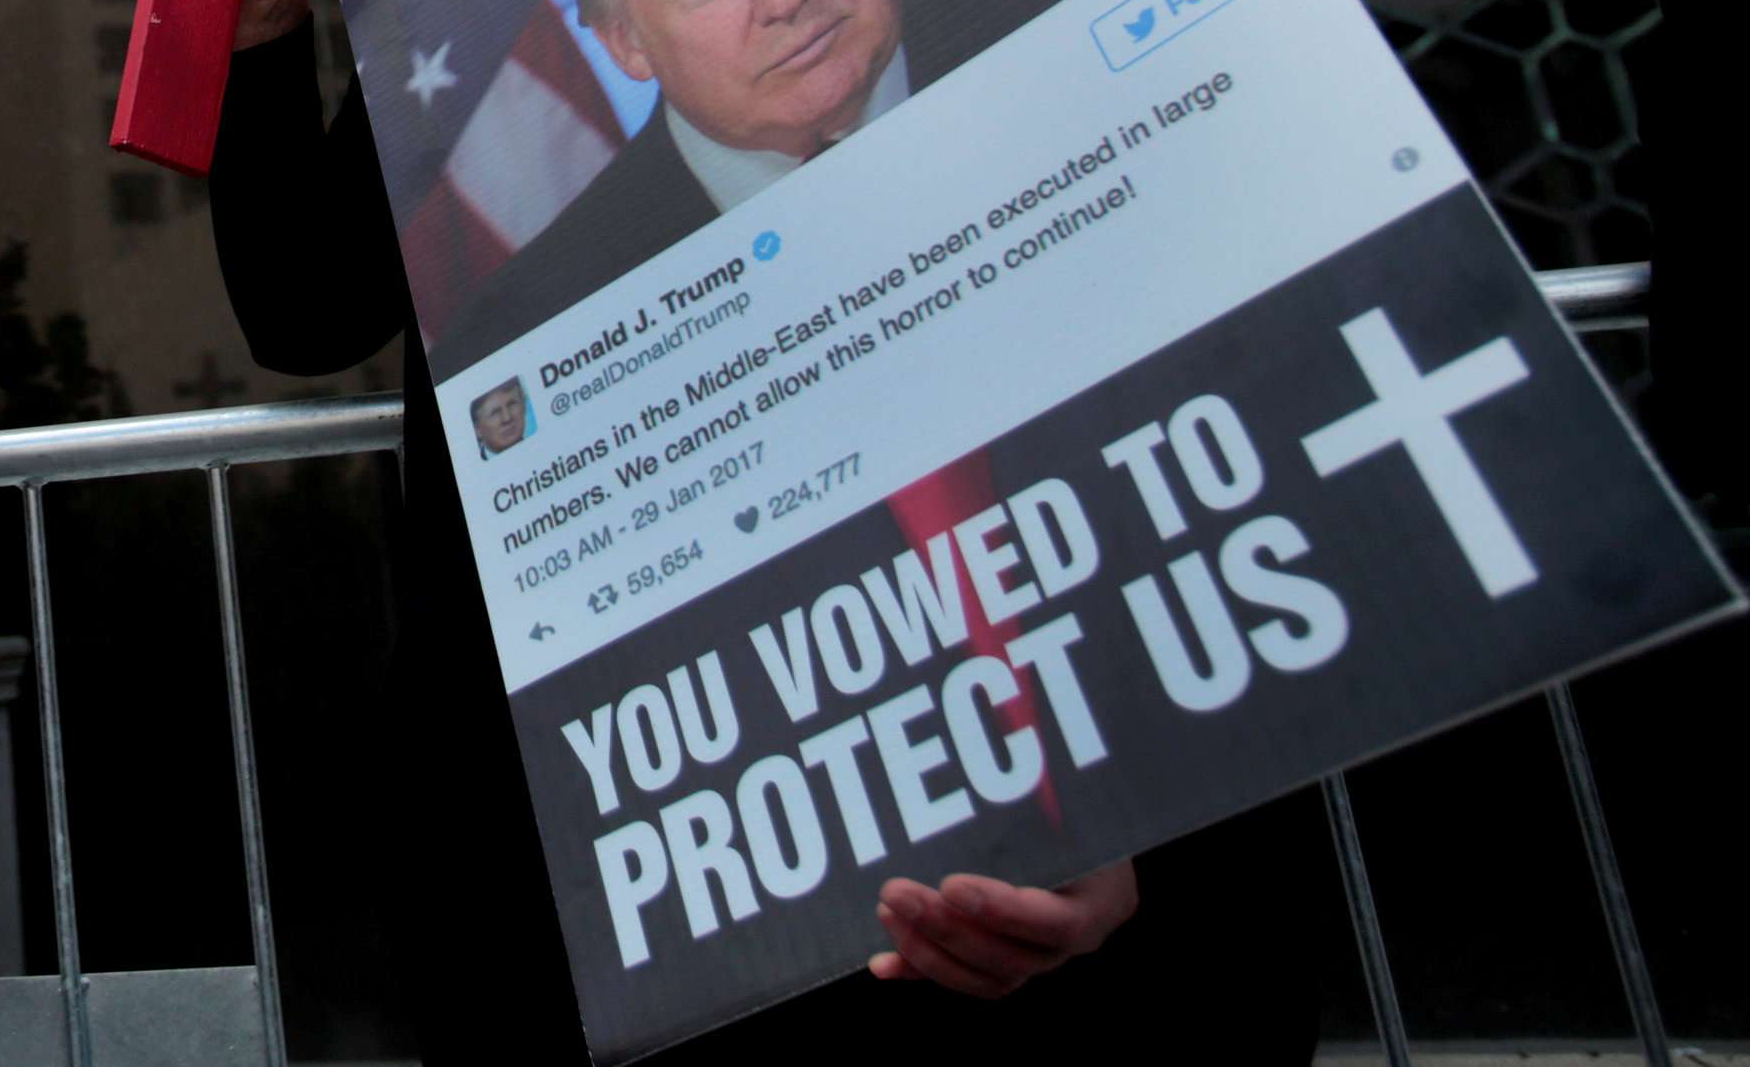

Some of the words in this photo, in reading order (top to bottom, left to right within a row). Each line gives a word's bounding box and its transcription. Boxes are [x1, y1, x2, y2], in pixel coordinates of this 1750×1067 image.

[492, 437, 608, 515] Christians
[612, 418, 637, 450] in
[640, 398, 681, 426] the
[684, 304, 837, 408] Middle-East
[838, 265, 907, 317] have
[909, 223, 982, 275] been
[986, 136, 1117, 231] executed
[1117, 119, 1151, 150] in
[1152, 69, 1234, 130] large
[502, 482, 611, 555] numbers.
[614, 447, 659, 490] We
[663, 400, 751, 463] cannot
[755, 363, 822, 413] allow
[825, 333, 877, 372] this
[879, 286, 962, 343] horror
[966, 263, 998, 291] to
[1002, 175, 1137, 270] continue!
[539, 322, 629, 388] Donald
[634, 309, 657, 334] J.
[659, 255, 746, 319] Trump
[549, 291, 751, 417] @realDonaldTrump
[513, 549, 573, 595] 10:03
[576, 525, 614, 564] AM
[630, 500, 660, 532] 29
[664, 477, 707, 513] Jan
[709, 441, 765, 488] 2017
[767, 452, 864, 522] 224,777
[560, 649, 741, 816] YOU
[749, 476, 1101, 725] VOWED
[1102, 393, 1265, 542] TO
[626, 541, 705, 598] 59,654
[593, 611, 1109, 971] PROTECT
[1122, 515, 1351, 713] US
